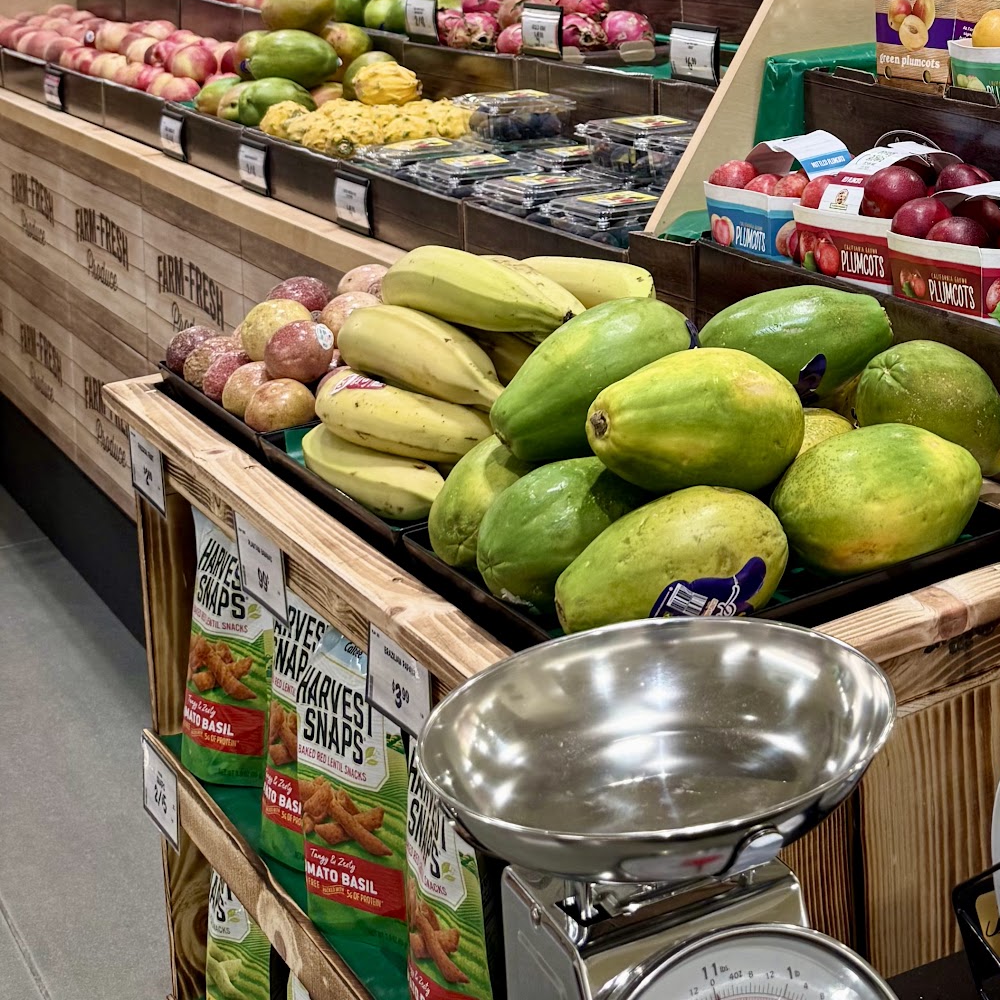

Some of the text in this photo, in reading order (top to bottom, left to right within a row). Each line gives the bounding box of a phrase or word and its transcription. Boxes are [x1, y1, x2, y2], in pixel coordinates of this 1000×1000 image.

[879, 53, 941, 68] green plumcots
[11, 173, 54, 228] FARM-FRESH
[75, 207, 129, 272] FARM-FRESH
[735, 225, 766, 252] PLUMCOTS
[86, 248, 118, 292] Produce
[841, 250, 885, 278] PLUMCOTS
[930, 273, 953, 283] CALIFORNIA
[157, 255, 224, 332] FARM-FRESH
[928, 278, 976, 310] PLUMCOTS
[197, 574, 247, 620] SNAPS
[221, 621, 249, 634] SNACKS
[296, 664, 373, 737] HARVEST
[201, 717, 235, 737] BASIL
[210, 734, 217, 742] OF
[303, 707, 365, 766] SNAPS
[298, 743, 367, 782] BAKED RED LENTIL SNACKS
[309, 847, 356, 874] Tangy & Zesty
[308, 877, 360, 901] FREE OF
[341, 873, 378, 895] BASIL
[423, 874, 448, 896] SNACKS
[765, 970, 775, 980] 12
[689, 987, 699, 997] 12
